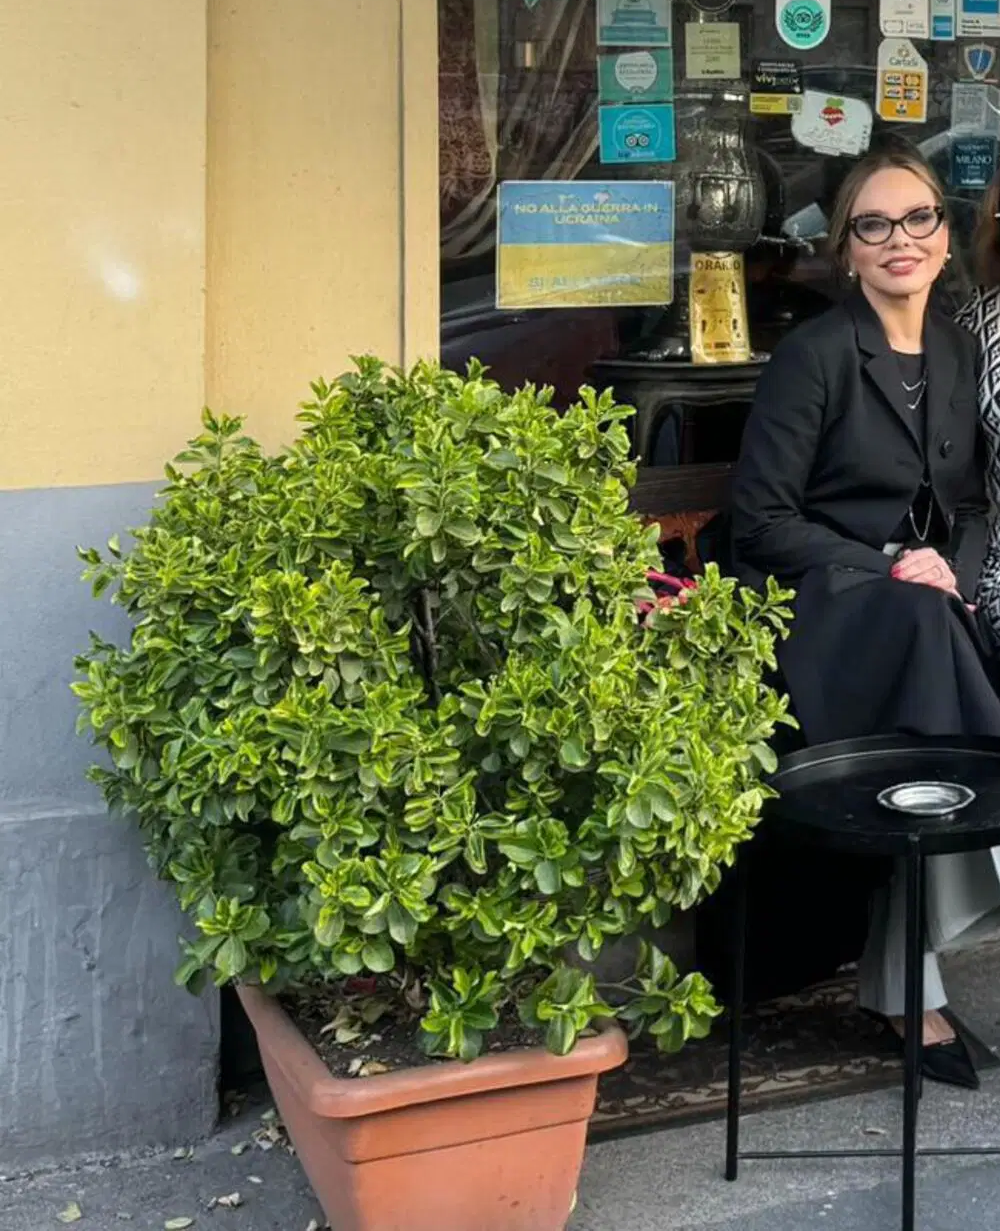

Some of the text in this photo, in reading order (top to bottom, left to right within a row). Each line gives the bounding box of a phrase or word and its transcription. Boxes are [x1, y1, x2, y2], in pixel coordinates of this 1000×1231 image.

[539, 203, 579, 214] ALLA
[580, 203, 641, 214] GUERRA
[554, 214, 620, 225] UCRAINA
